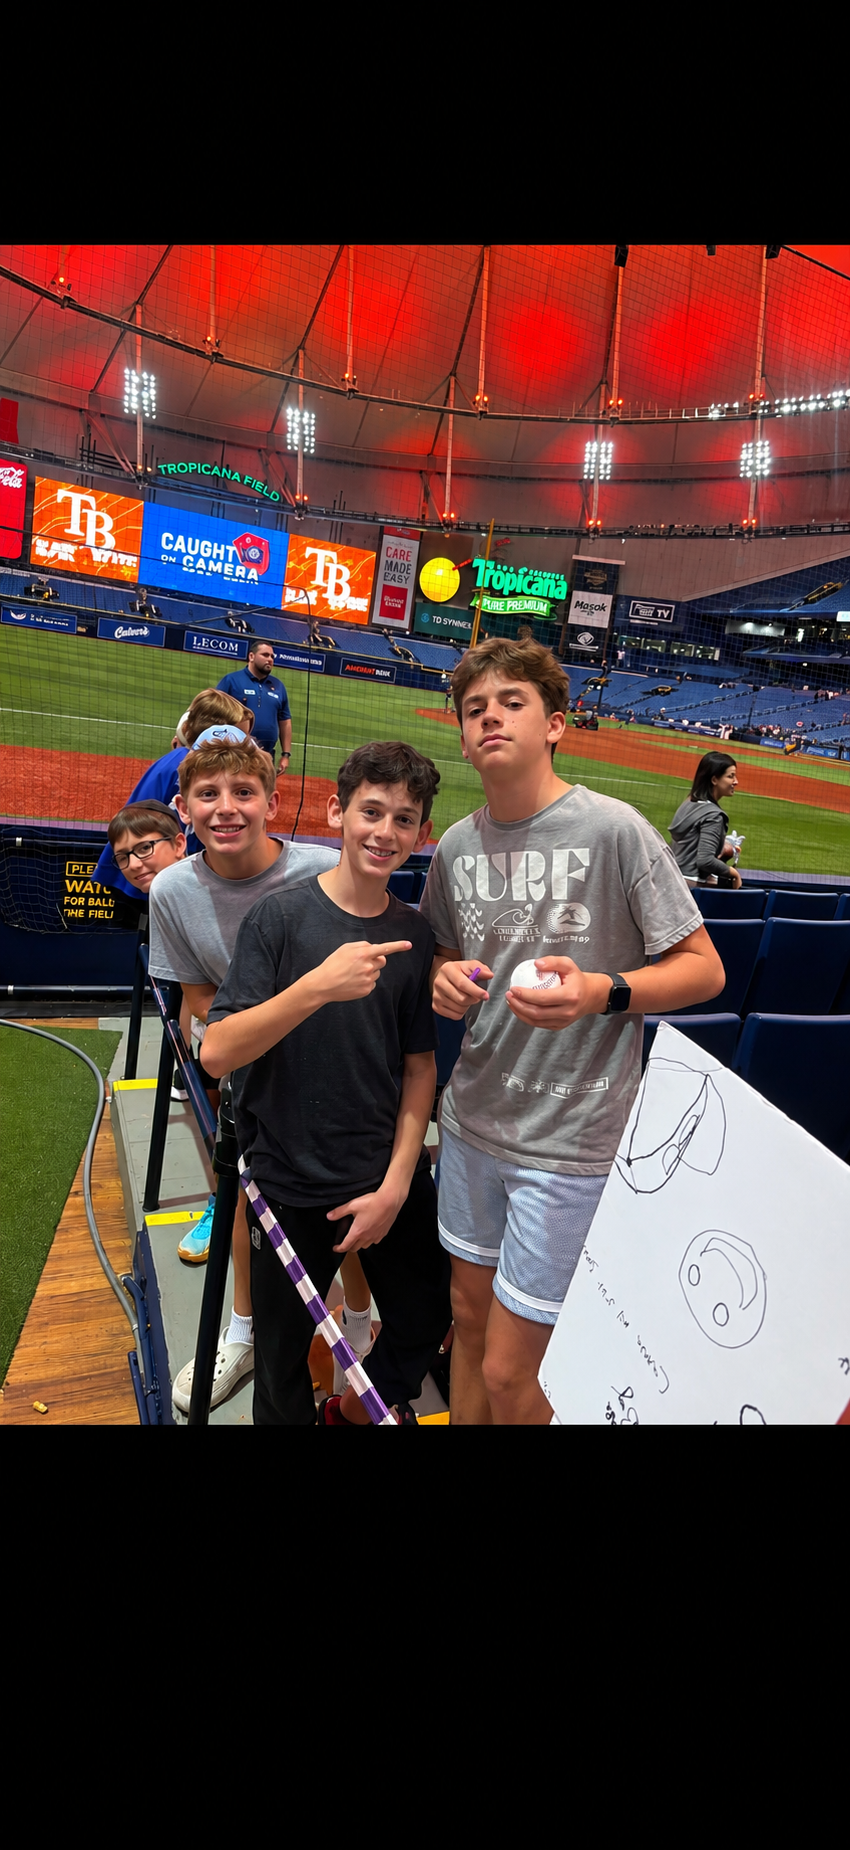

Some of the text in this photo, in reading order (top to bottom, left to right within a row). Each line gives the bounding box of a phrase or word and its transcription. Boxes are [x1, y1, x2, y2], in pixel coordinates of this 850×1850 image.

[158, 463, 280, 501] TROPICANA FIELD
[56, 489, 116, 550] TB
[161, 532, 237, 562] CAUGHT
[386, 546, 412, 562] CARE
[161, 554, 259, 581] ON CAMERA
[305, 546, 351, 601] TB
[384, 560, 412, 575] MADE
[383, 572, 410, 584] EASY
[472, 558, 568, 600] Tropicana
[432, 615, 442, 624] TD
[657, 609, 671, 619] TV
[193, 636, 239, 652] LECOM
[72, 864, 98, 874] PLE
[452, 848, 590, 902] SURF
[64, 896, 85, 905] FOR
[64, 909, 84, 917] THE
